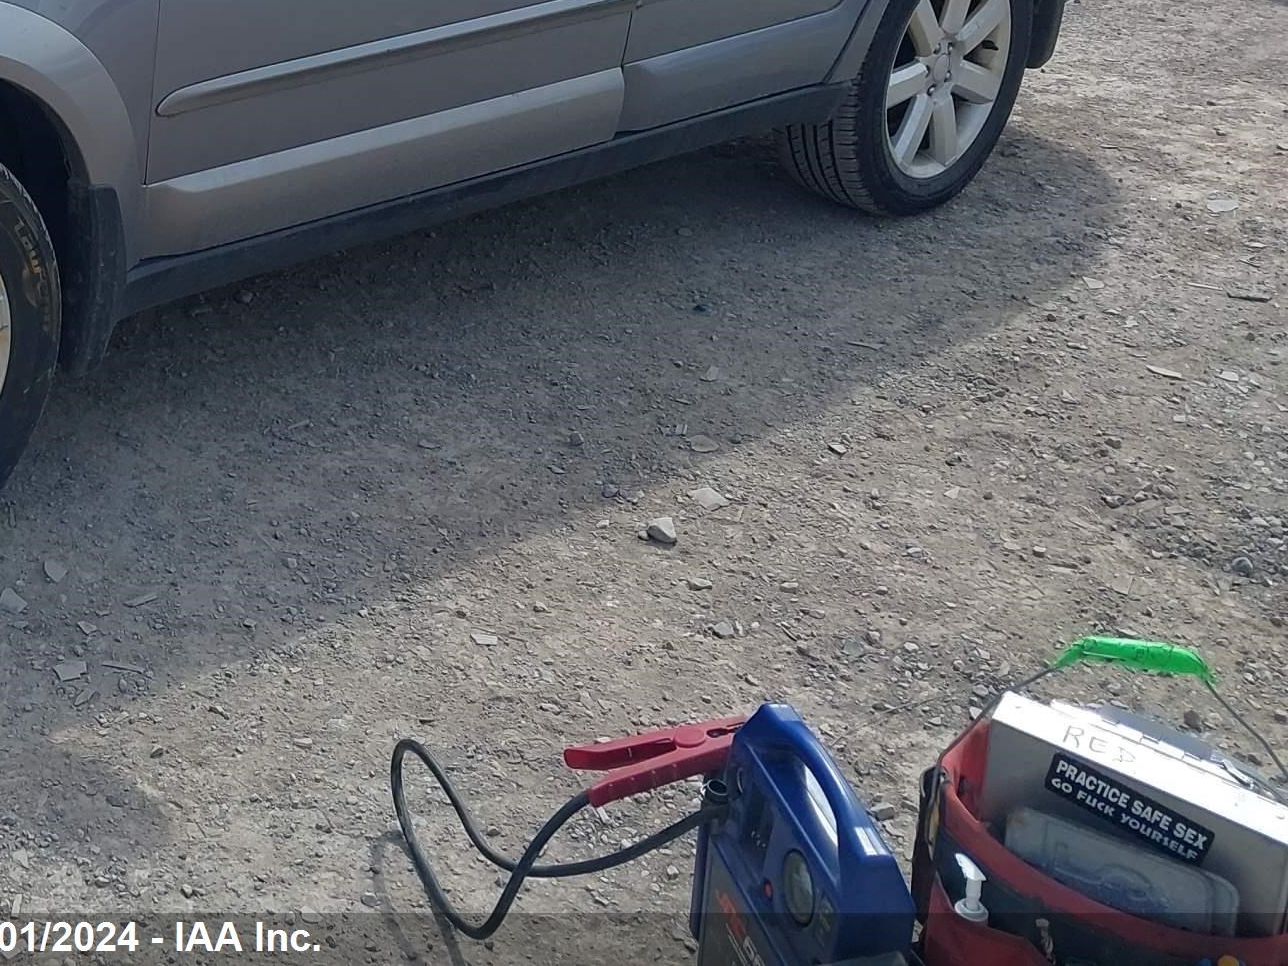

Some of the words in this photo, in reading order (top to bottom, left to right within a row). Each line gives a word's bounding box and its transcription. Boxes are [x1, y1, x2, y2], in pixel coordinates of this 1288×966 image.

[1062, 724, 1137, 763] RED
[1050, 777, 1073, 795] GO
[1075, 789, 1115, 819] FUCK
[1120, 812, 1199, 863] YOURSELF
[1055, 759, 1130, 808] PRACTICE
[1130, 797, 1172, 832] SAFE
[1174, 820, 1208, 850] SEX
